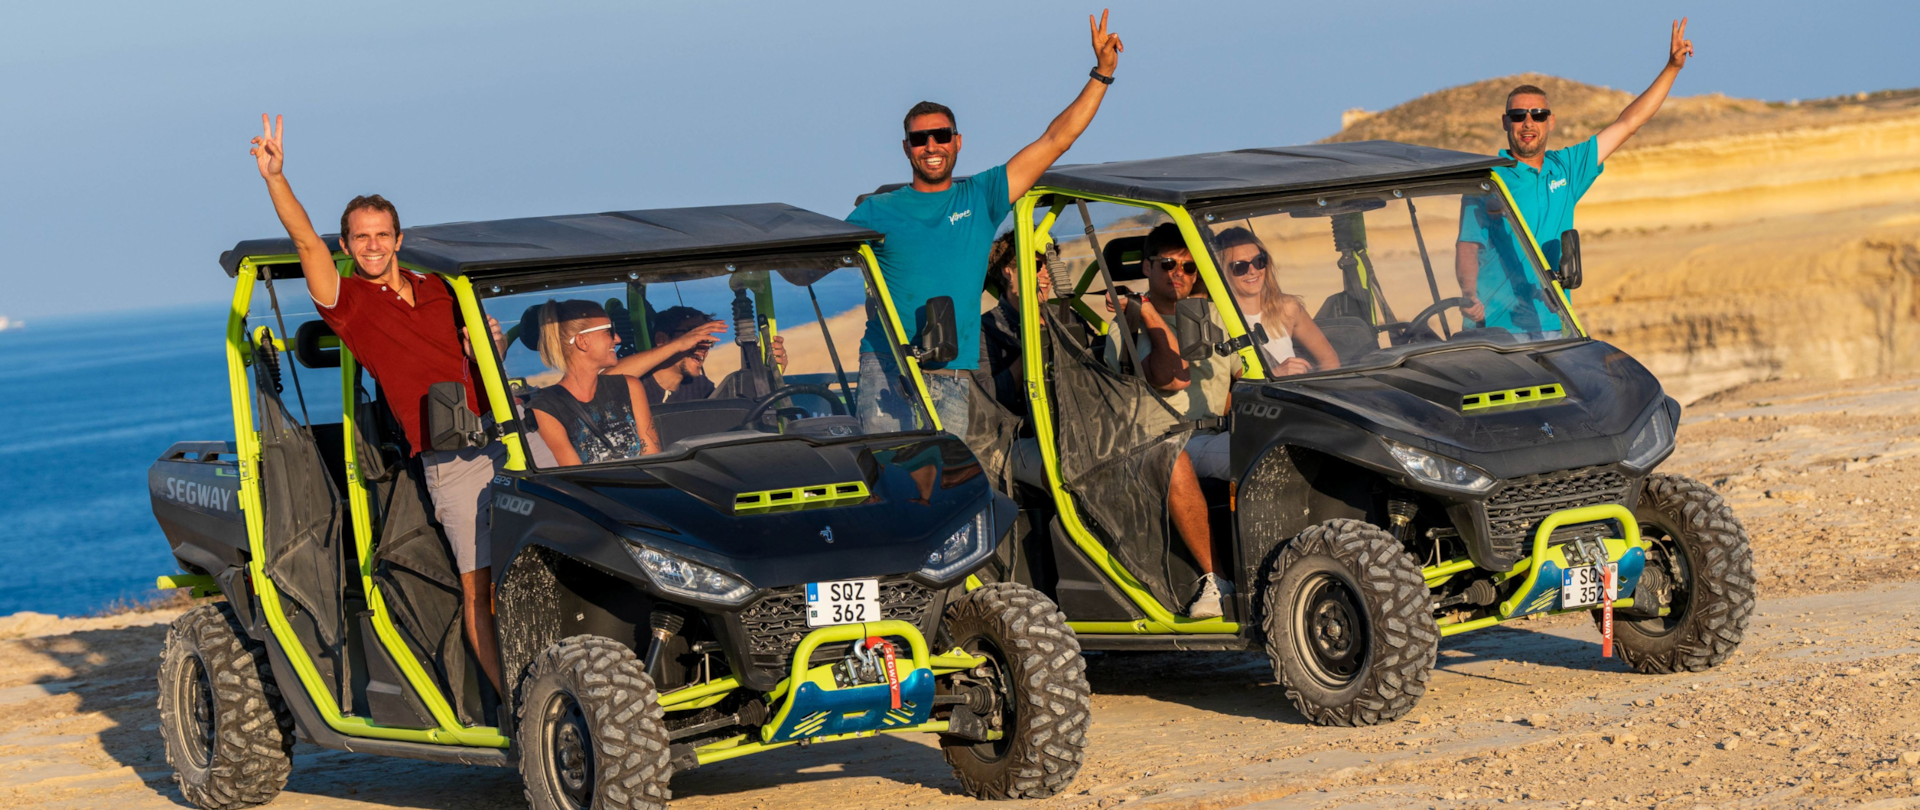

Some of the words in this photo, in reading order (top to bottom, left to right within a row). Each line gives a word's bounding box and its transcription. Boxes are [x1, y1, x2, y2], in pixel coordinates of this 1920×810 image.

[1236, 402, 1282, 419] 1000
[494, 475, 512, 486] EPS
[166, 477, 231, 512] SEGWAY
[495, 493, 535, 516] 1000
[831, 582, 865, 602] SQZ
[1580, 586, 1604, 603] 352
[833, 603, 865, 622] 362
[885, 647, 898, 691] SEGWAY
